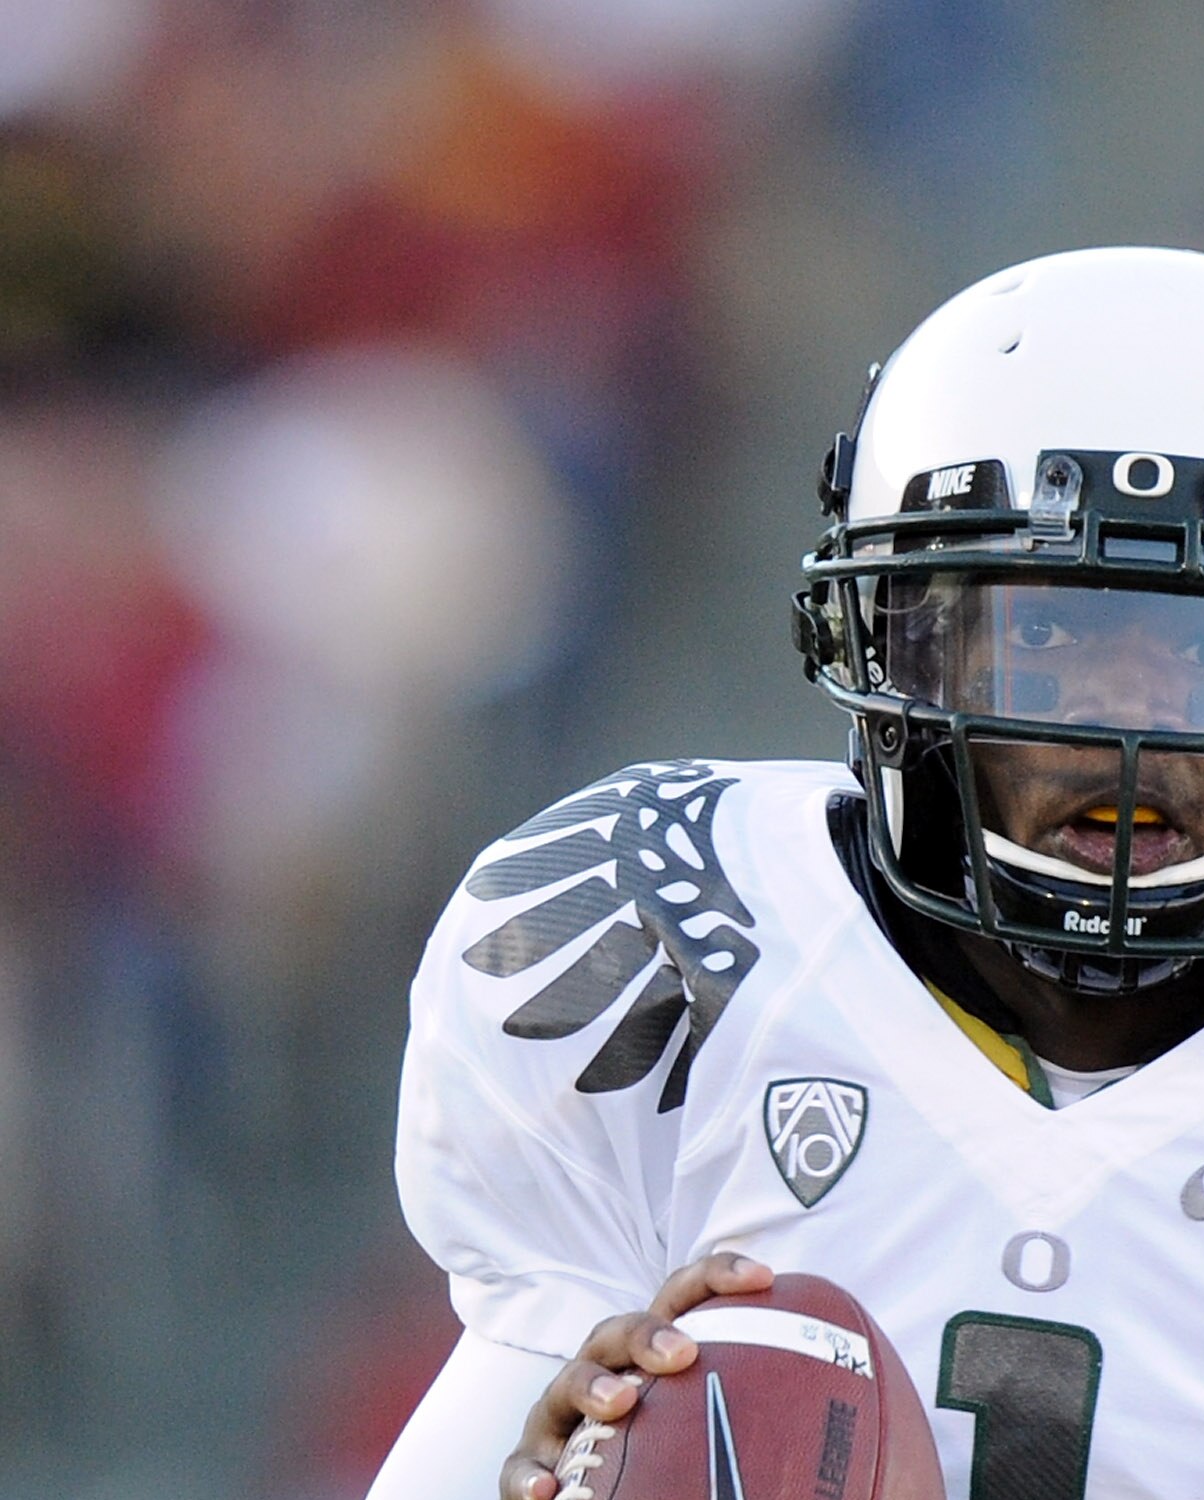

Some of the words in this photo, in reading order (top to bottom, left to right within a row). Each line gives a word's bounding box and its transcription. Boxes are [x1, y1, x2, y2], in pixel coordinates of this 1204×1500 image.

[927, 464, 976, 500] NIKE
[1112, 452, 1175, 497] O
[768, 1081, 864, 1156] PAC
[787, 1133, 843, 1177] 10
[1003, 1231, 1071, 1292] O
